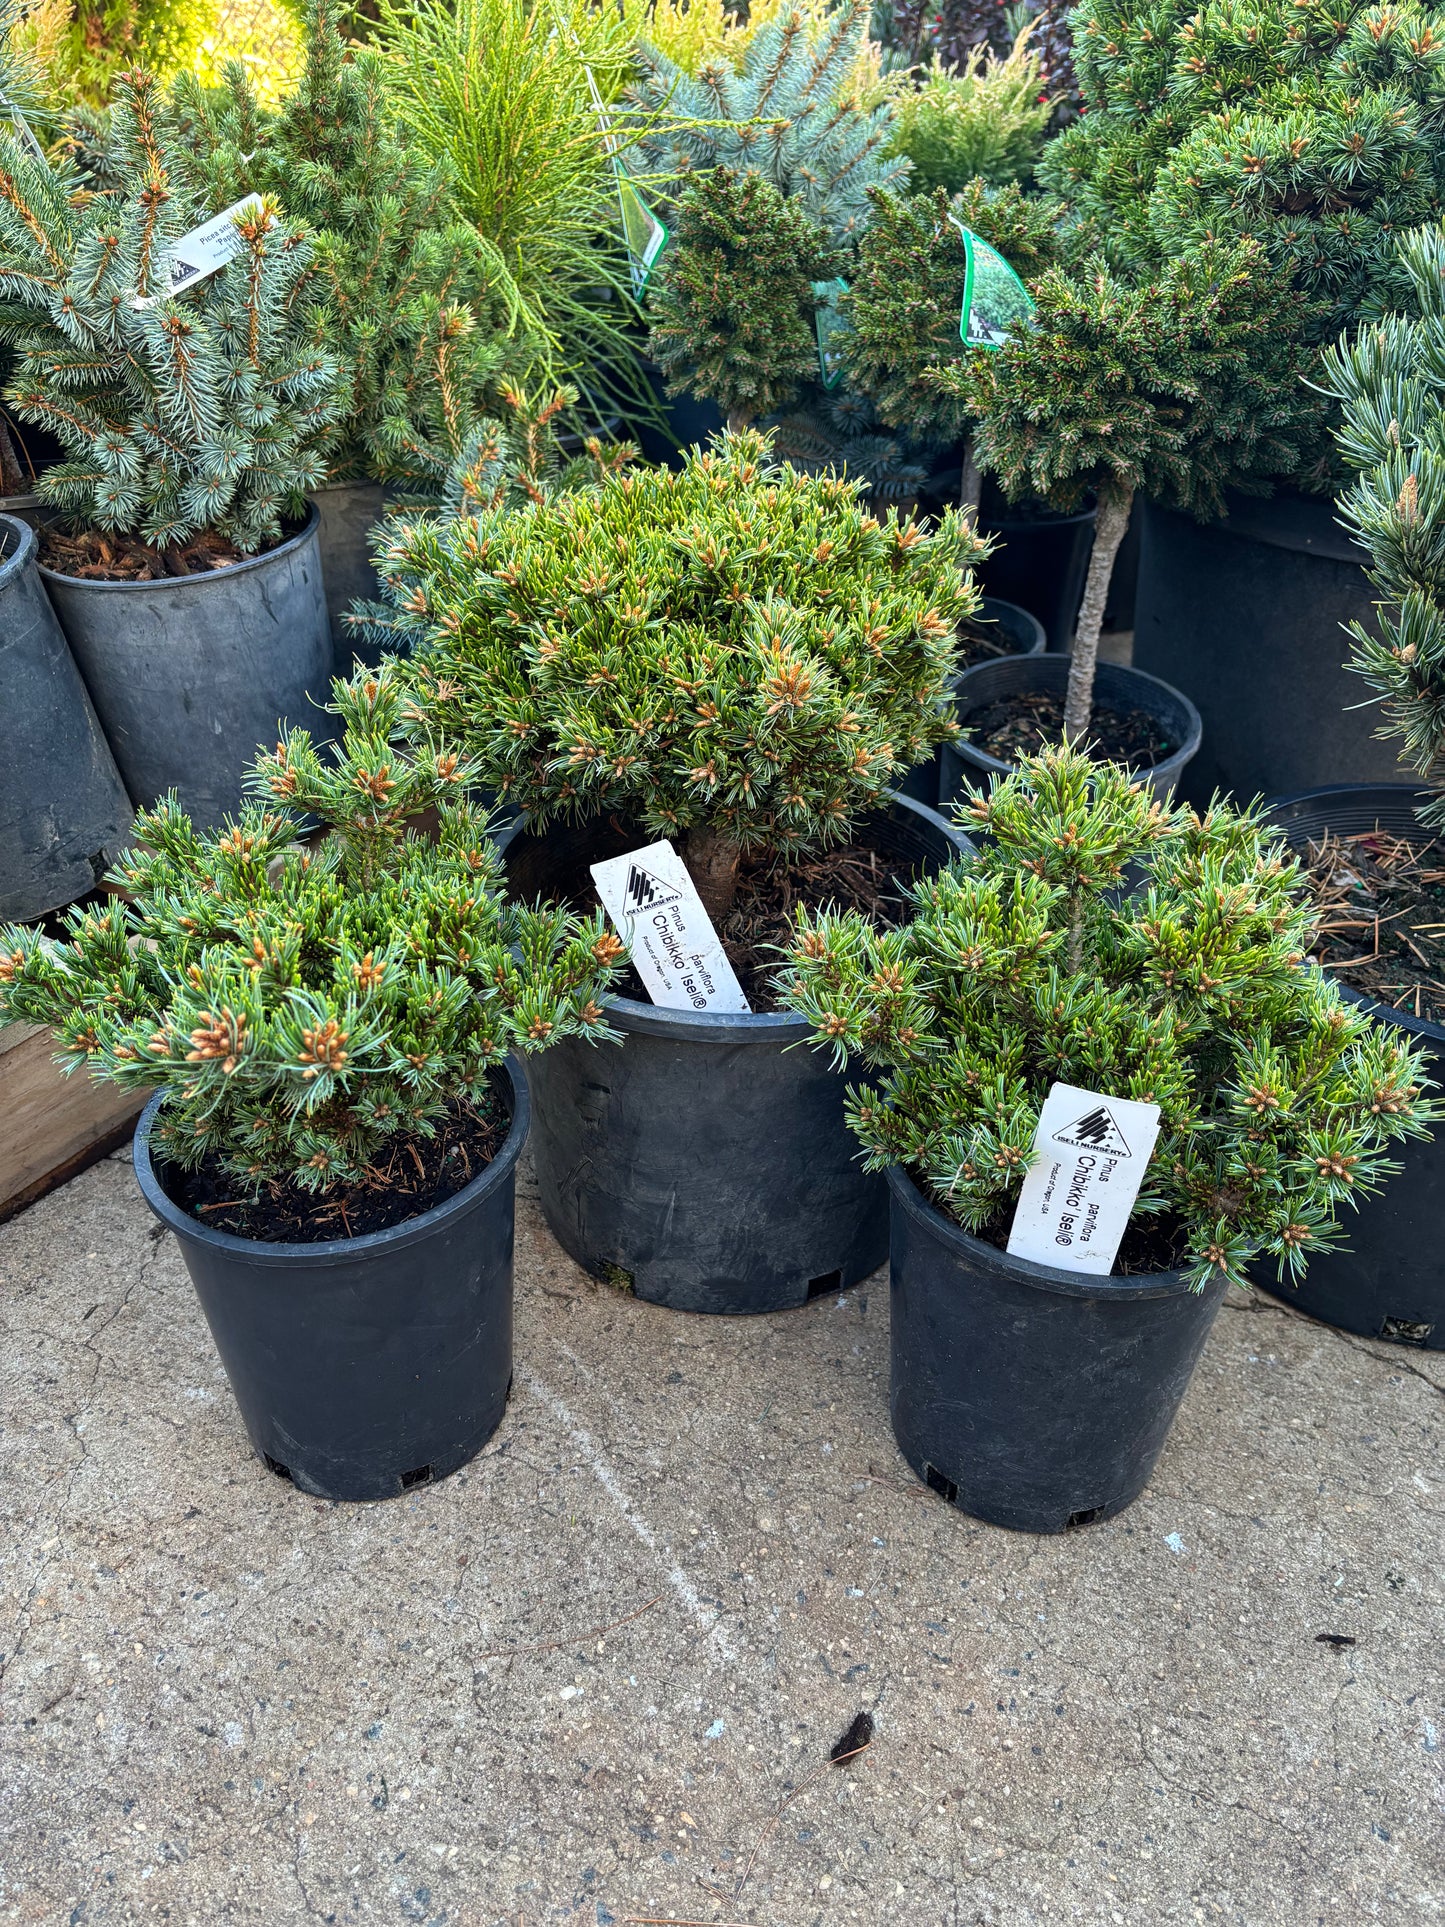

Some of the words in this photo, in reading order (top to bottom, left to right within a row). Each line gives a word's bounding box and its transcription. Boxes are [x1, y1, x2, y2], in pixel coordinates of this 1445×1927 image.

[199, 230, 219, 245] Picea
[219, 222, 232, 234] sitc
[626, 906, 644, 916] ISELI
[668, 905, 686, 932] Pinus
[690, 954, 716, 995] parviflora
[641, 935, 654, 954] Product
[663, 979, 673, 990] USA
[1057, 1136, 1079, 1146] ISELI
[1050, 1162, 1061, 1180] Product
[1098, 1157, 1118, 1182] Pinus
[1041, 1203, 1050, 1214] USA
[1079, 1203, 1100, 1242] parviflora
